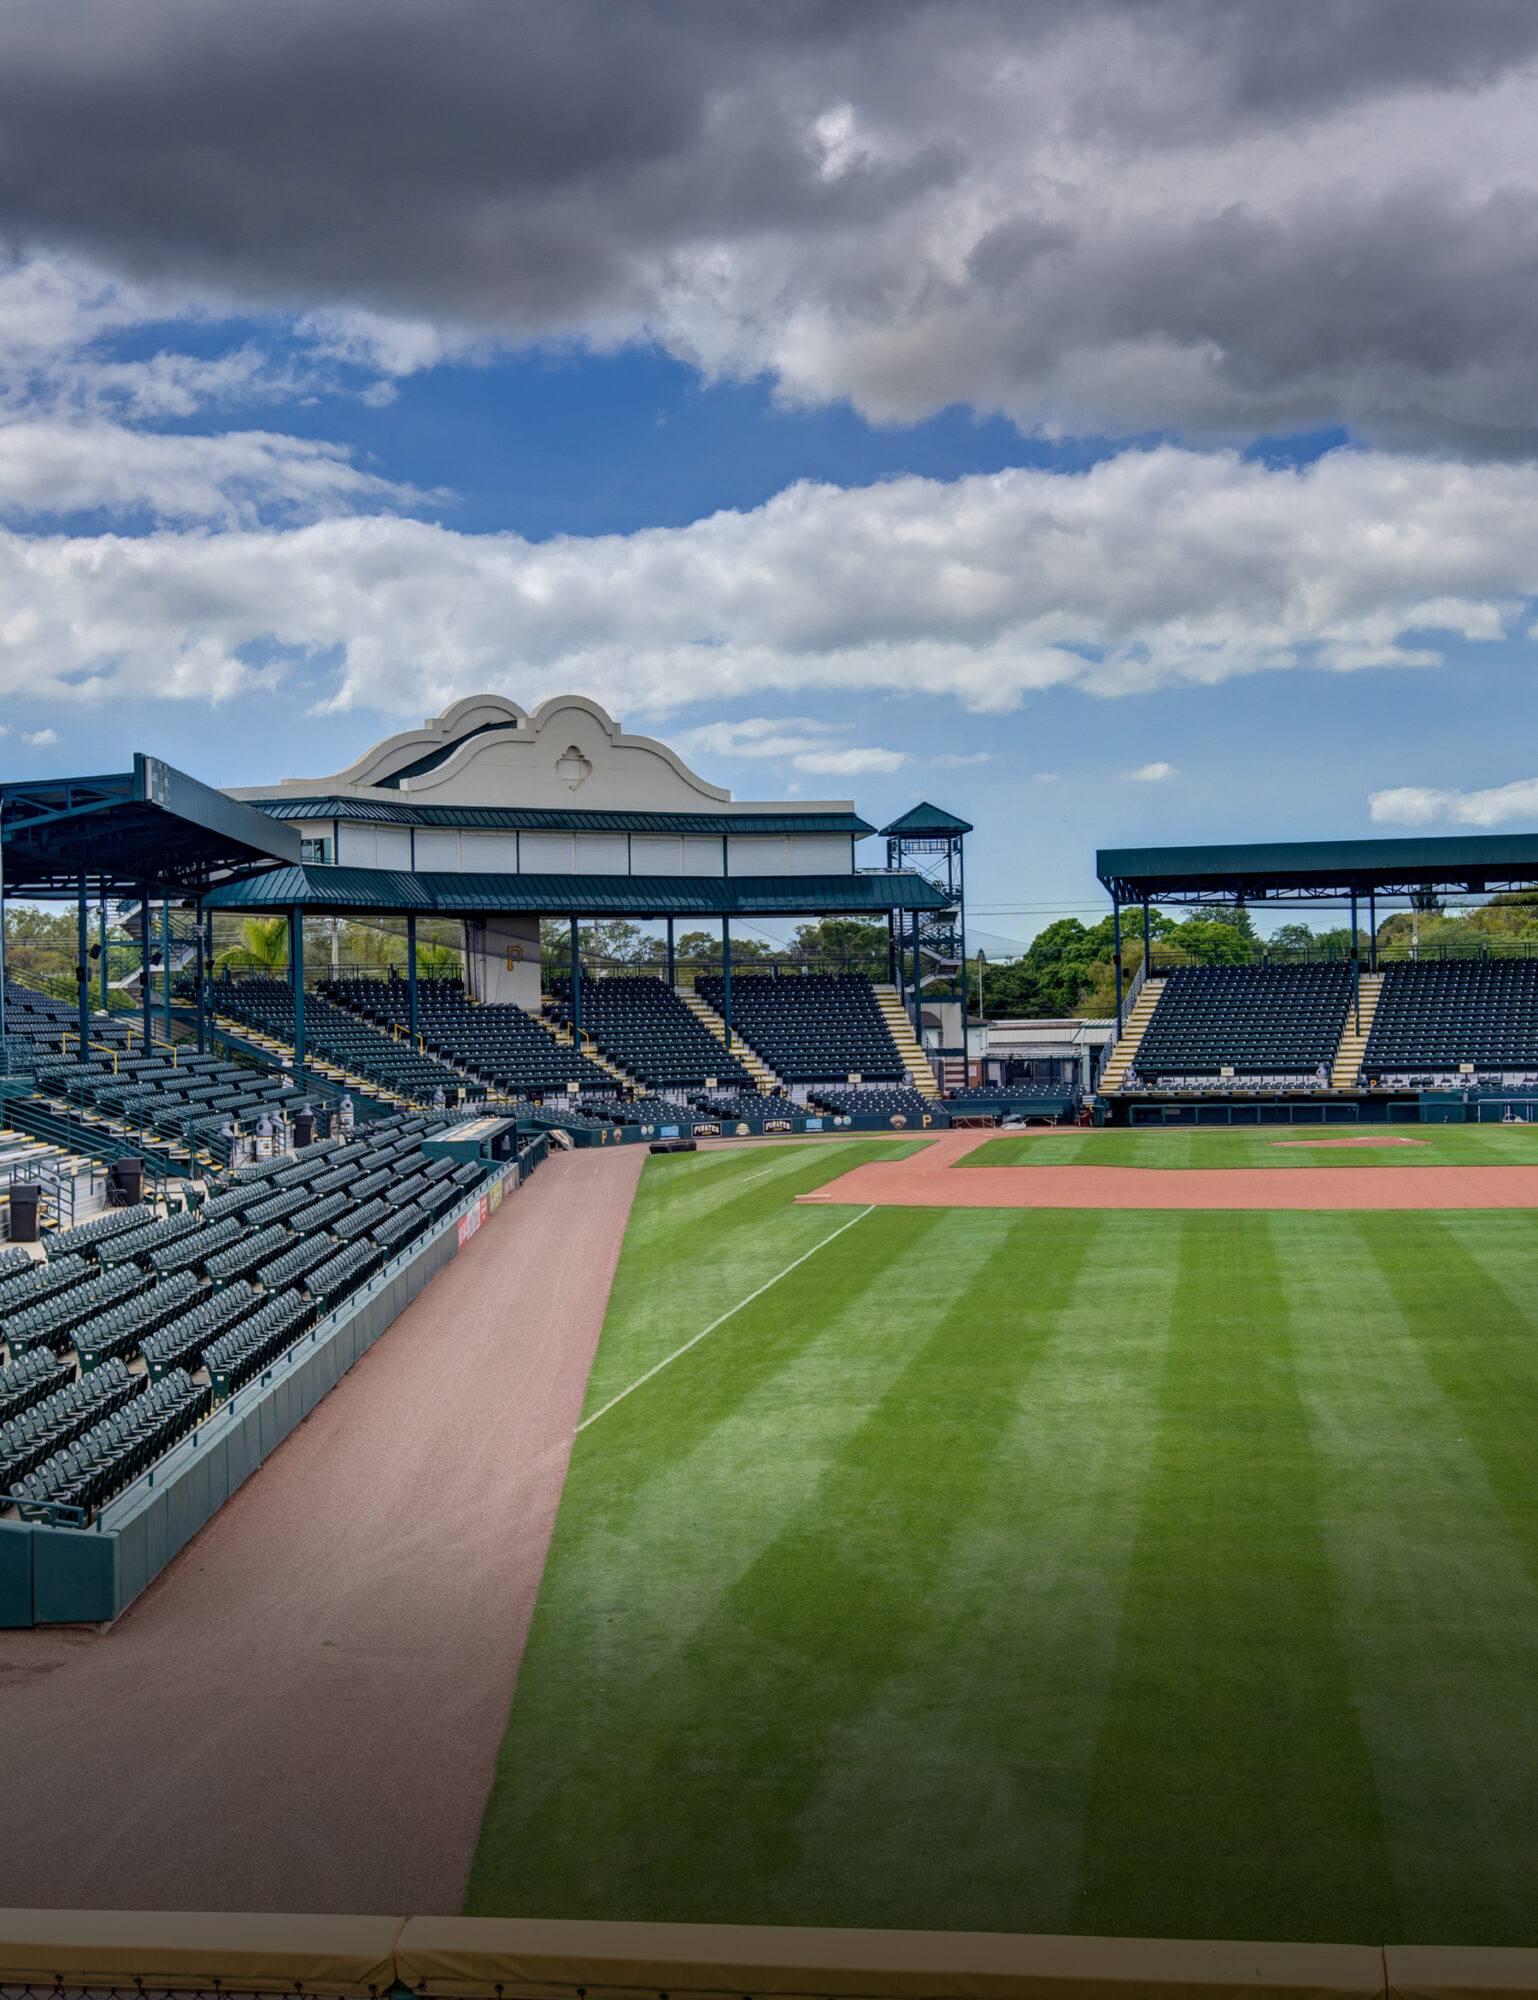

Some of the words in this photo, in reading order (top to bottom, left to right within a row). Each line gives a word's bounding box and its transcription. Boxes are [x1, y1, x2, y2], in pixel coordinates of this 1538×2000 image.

[507, 945, 523, 971] P
[765, 1121, 791, 1131] PIRATES
[922, 1114, 932, 1128] P
[601, 1129, 607, 1144] P
[693, 1124, 720, 1135] PIRATES
